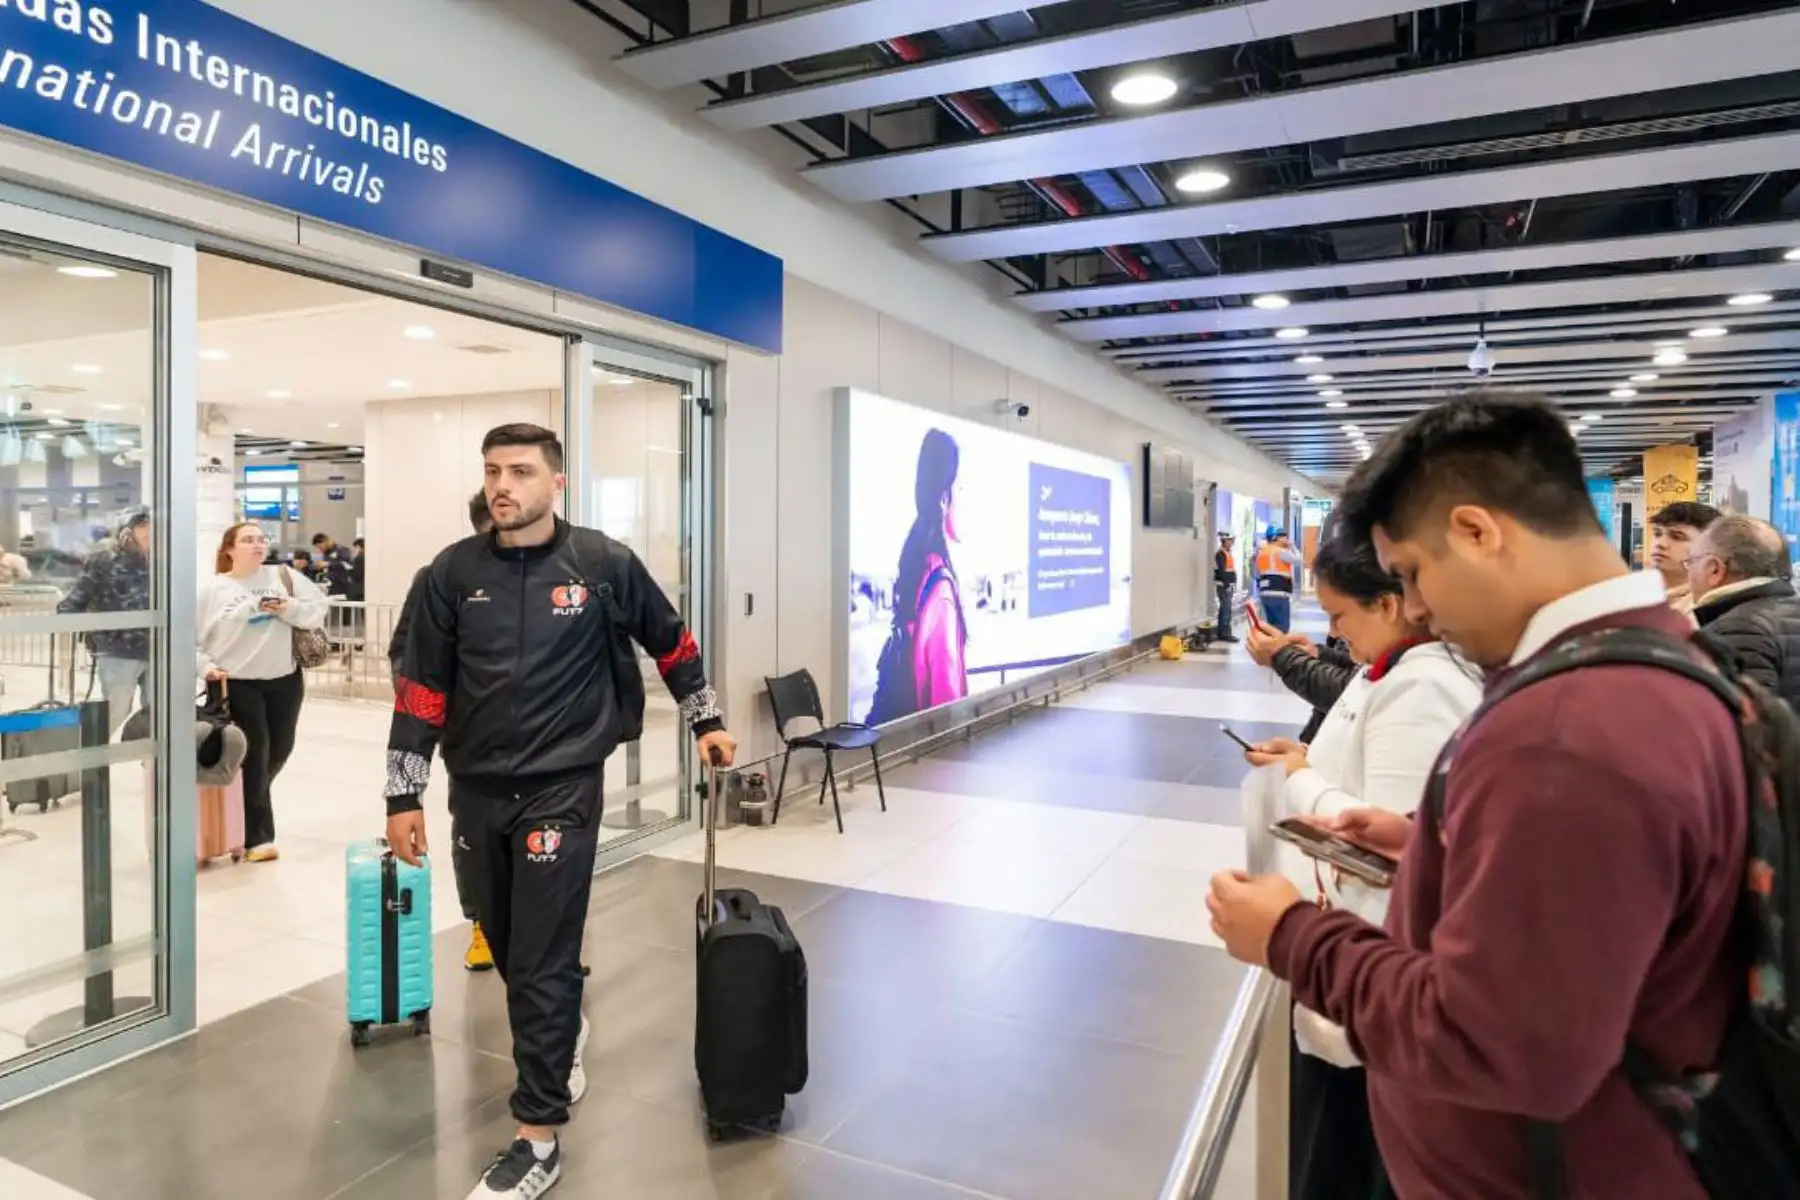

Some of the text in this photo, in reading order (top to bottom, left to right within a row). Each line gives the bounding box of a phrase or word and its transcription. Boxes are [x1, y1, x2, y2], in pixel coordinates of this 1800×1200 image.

[0, 0, 447, 172] as Internacionales
[230, 123, 385, 204] Arrivals
